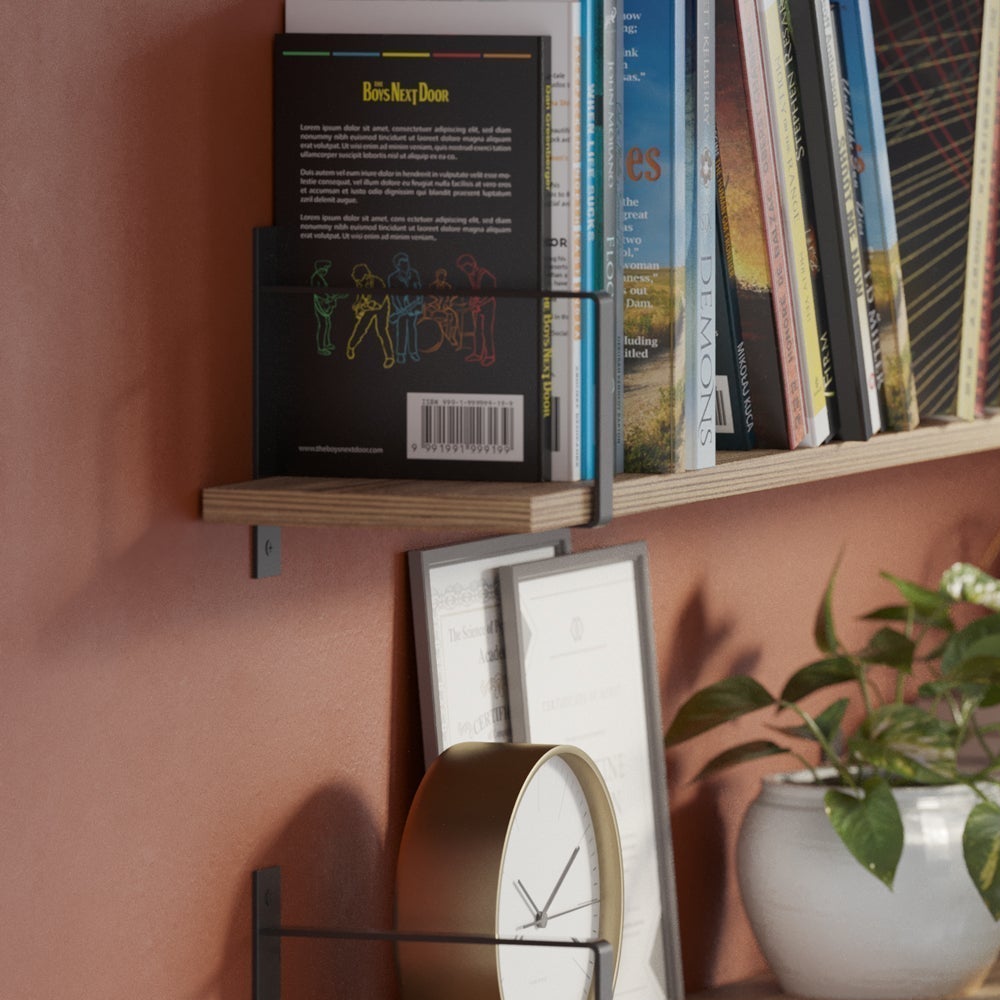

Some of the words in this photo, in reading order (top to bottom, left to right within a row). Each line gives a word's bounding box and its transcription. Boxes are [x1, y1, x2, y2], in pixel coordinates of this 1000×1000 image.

[363, 82, 390, 102] BOYS
[391, 82, 418, 106] NEXT
[418, 82, 450, 102] DOOR
[544, 84, 552, 110] Dan
[586, 84, 596, 134] WHEN
[788, 74, 804, 161] STEPHEN
[544, 114, 552, 191] Greenberger
[586, 137, 596, 178] LIFE
[606, 236, 615, 296] FLOC
[542, 350, 553, 384] NEXT
[700, 256, 714, 446] DEMONS
[744, 396, 754, 433] KUCA
[298, 446, 384, 454] www.theboysnextdoor.com
